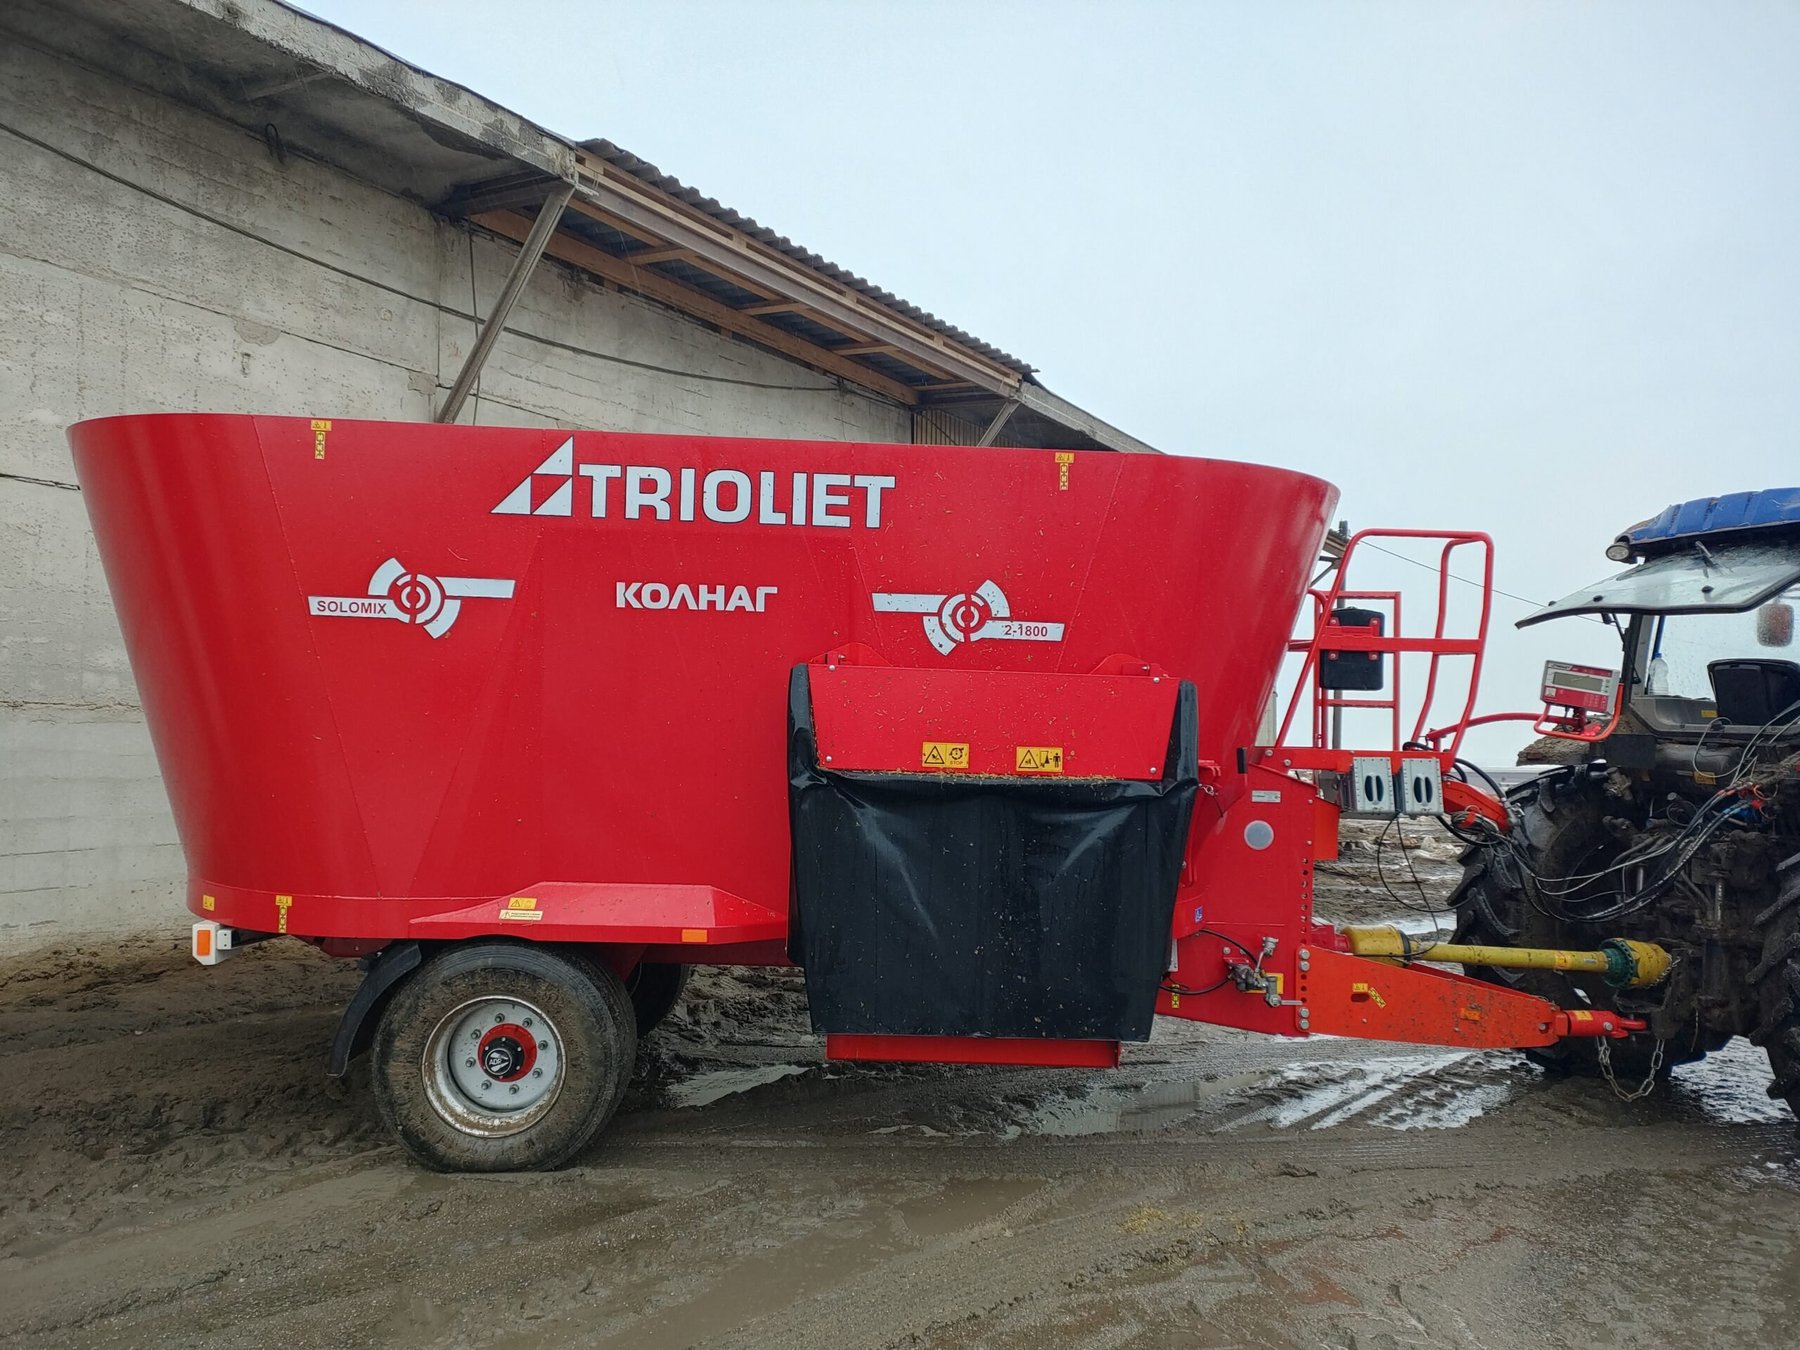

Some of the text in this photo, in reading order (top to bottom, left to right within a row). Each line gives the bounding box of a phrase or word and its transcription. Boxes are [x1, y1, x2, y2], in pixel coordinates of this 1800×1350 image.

[579, 463, 896, 529] TRIOLIET
[317, 600, 387, 614] SOLOMIX
[616, 582, 778, 612] КОЛНАГ
[1004, 623, 1048, 637] 2-1800
